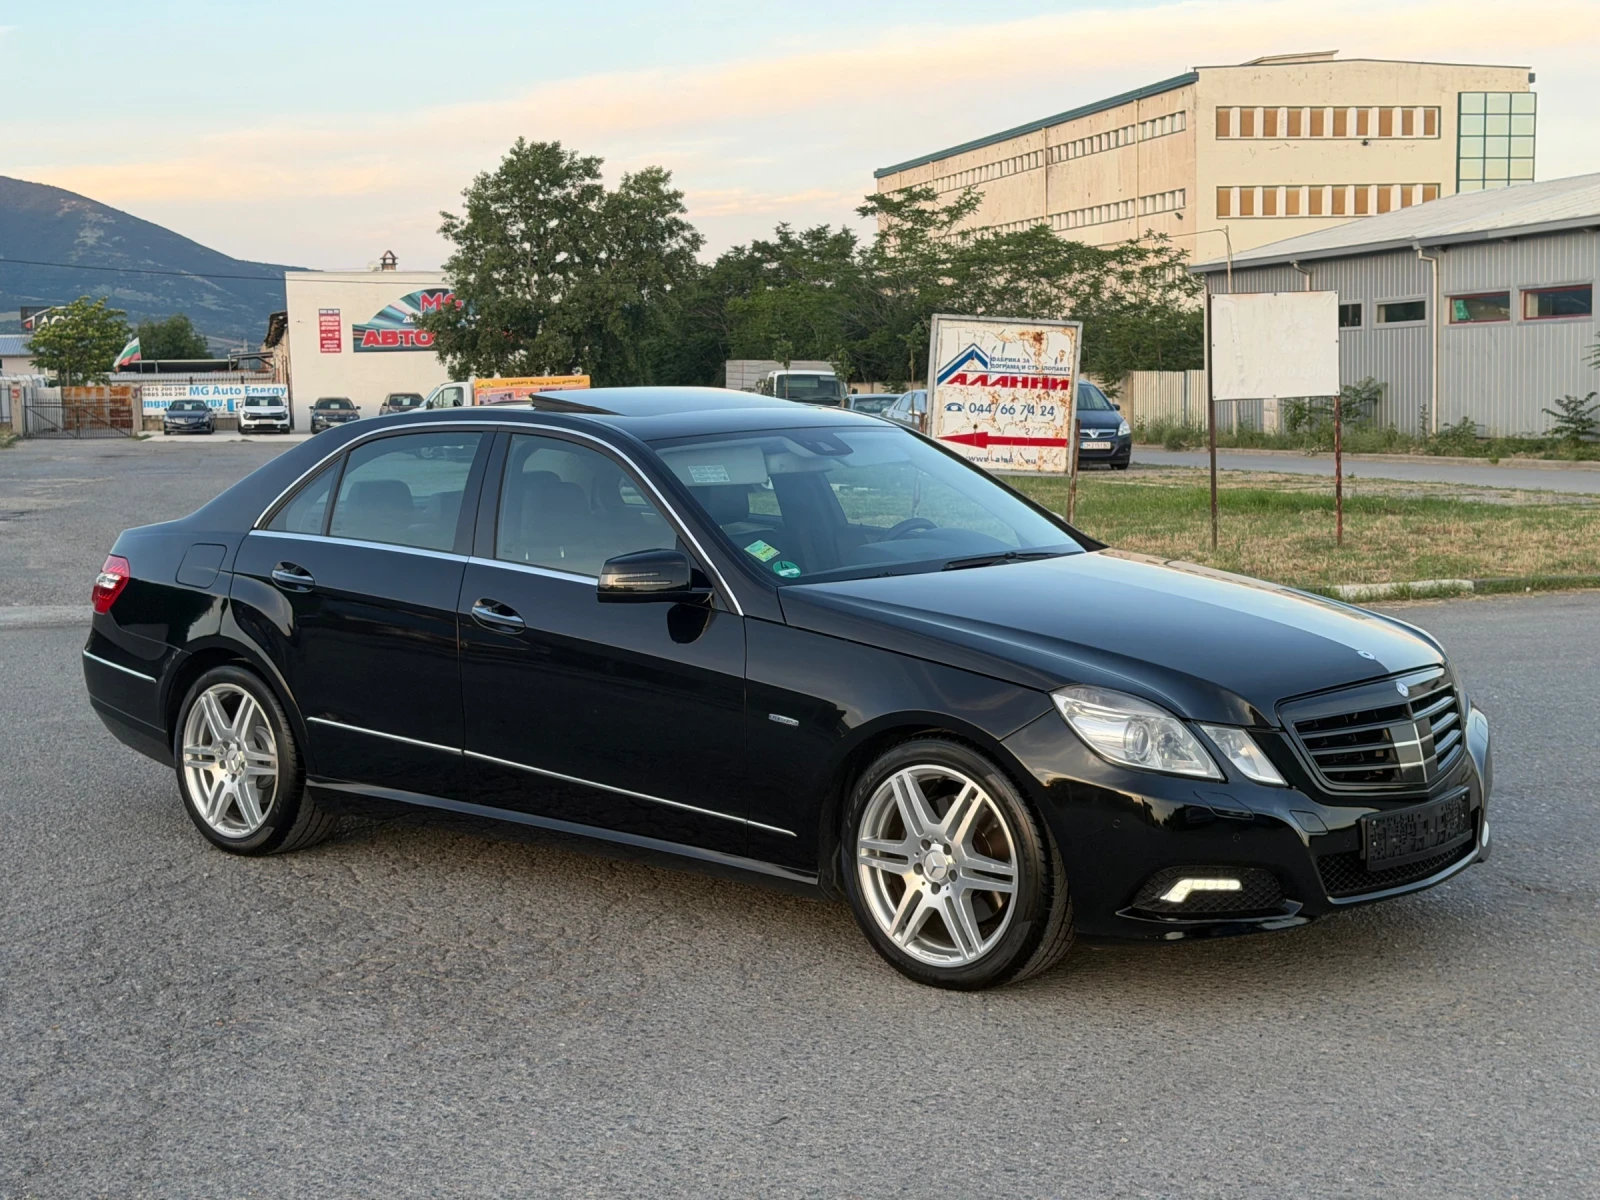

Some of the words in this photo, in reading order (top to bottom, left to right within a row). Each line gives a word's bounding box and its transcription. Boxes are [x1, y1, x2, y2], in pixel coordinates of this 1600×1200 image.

[361, 329, 436, 347] АВТО
[946, 373, 1069, 390] АЛАННИ
[189, 386, 209, 396] MG
[213, 385, 242, 396] Auto
[244, 385, 287, 397] Energy
[1039, 405, 1055, 416] 24
